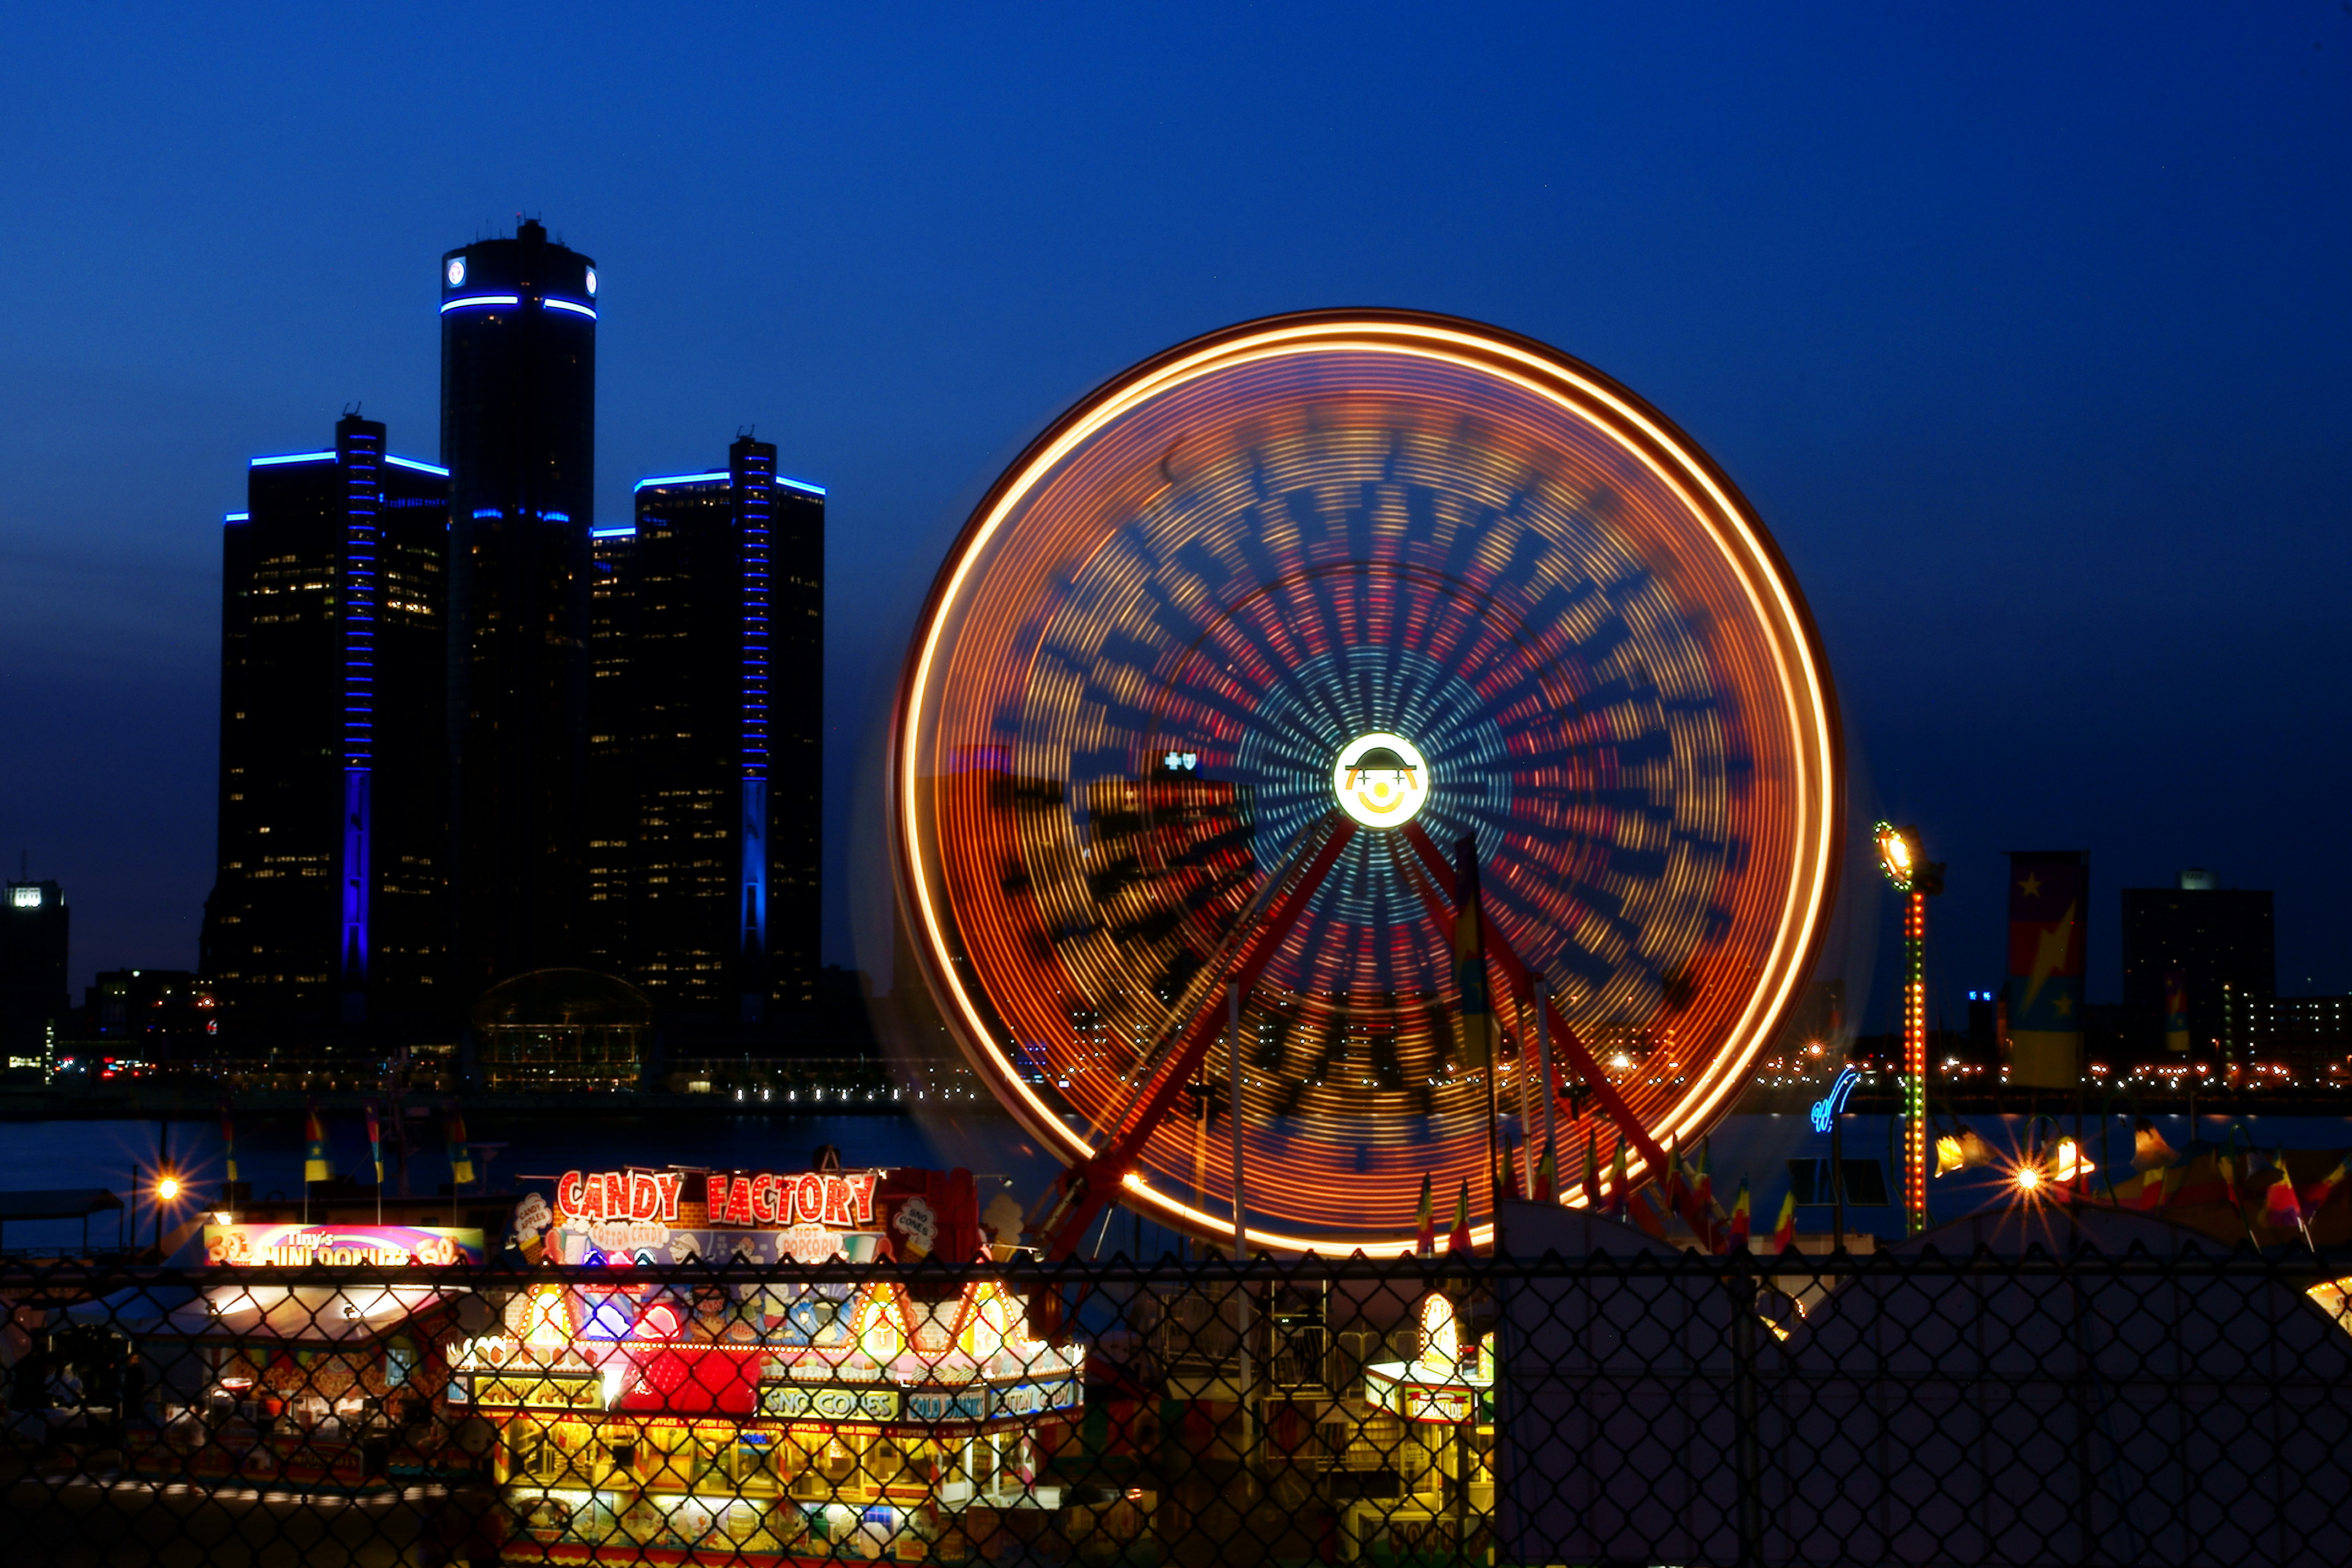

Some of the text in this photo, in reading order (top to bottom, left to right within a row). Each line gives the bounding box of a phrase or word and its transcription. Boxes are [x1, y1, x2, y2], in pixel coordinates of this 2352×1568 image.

[558, 1170, 877, 1226] CANDY FACTORY
[520, 1204, 540, 1220] CANDY
[522, 1212, 546, 1230] APPLES
[909, 1208, 928, 1223] SNO
[794, 1227, 819, 1238] HOT
[899, 1216, 929, 1236] CONES
[287, 1230, 334, 1251] Tiny's
[593, 1226, 665, 1246] COTTON CANDY
[262, 1245, 411, 1267] MINI DONUTS
[783, 1238, 837, 1256] POPCORN
[480, 1379, 595, 1404] CANDY APPLES
[765, 1391, 892, 1417] SNO CONES
[909, 1395, 984, 1419] COLD DRINKS
[1412, 1400, 1463, 1419] LEMONADE
[897, 1428, 936, 1438] POPCOR
[952, 1425, 992, 1436] SNO-CNES
